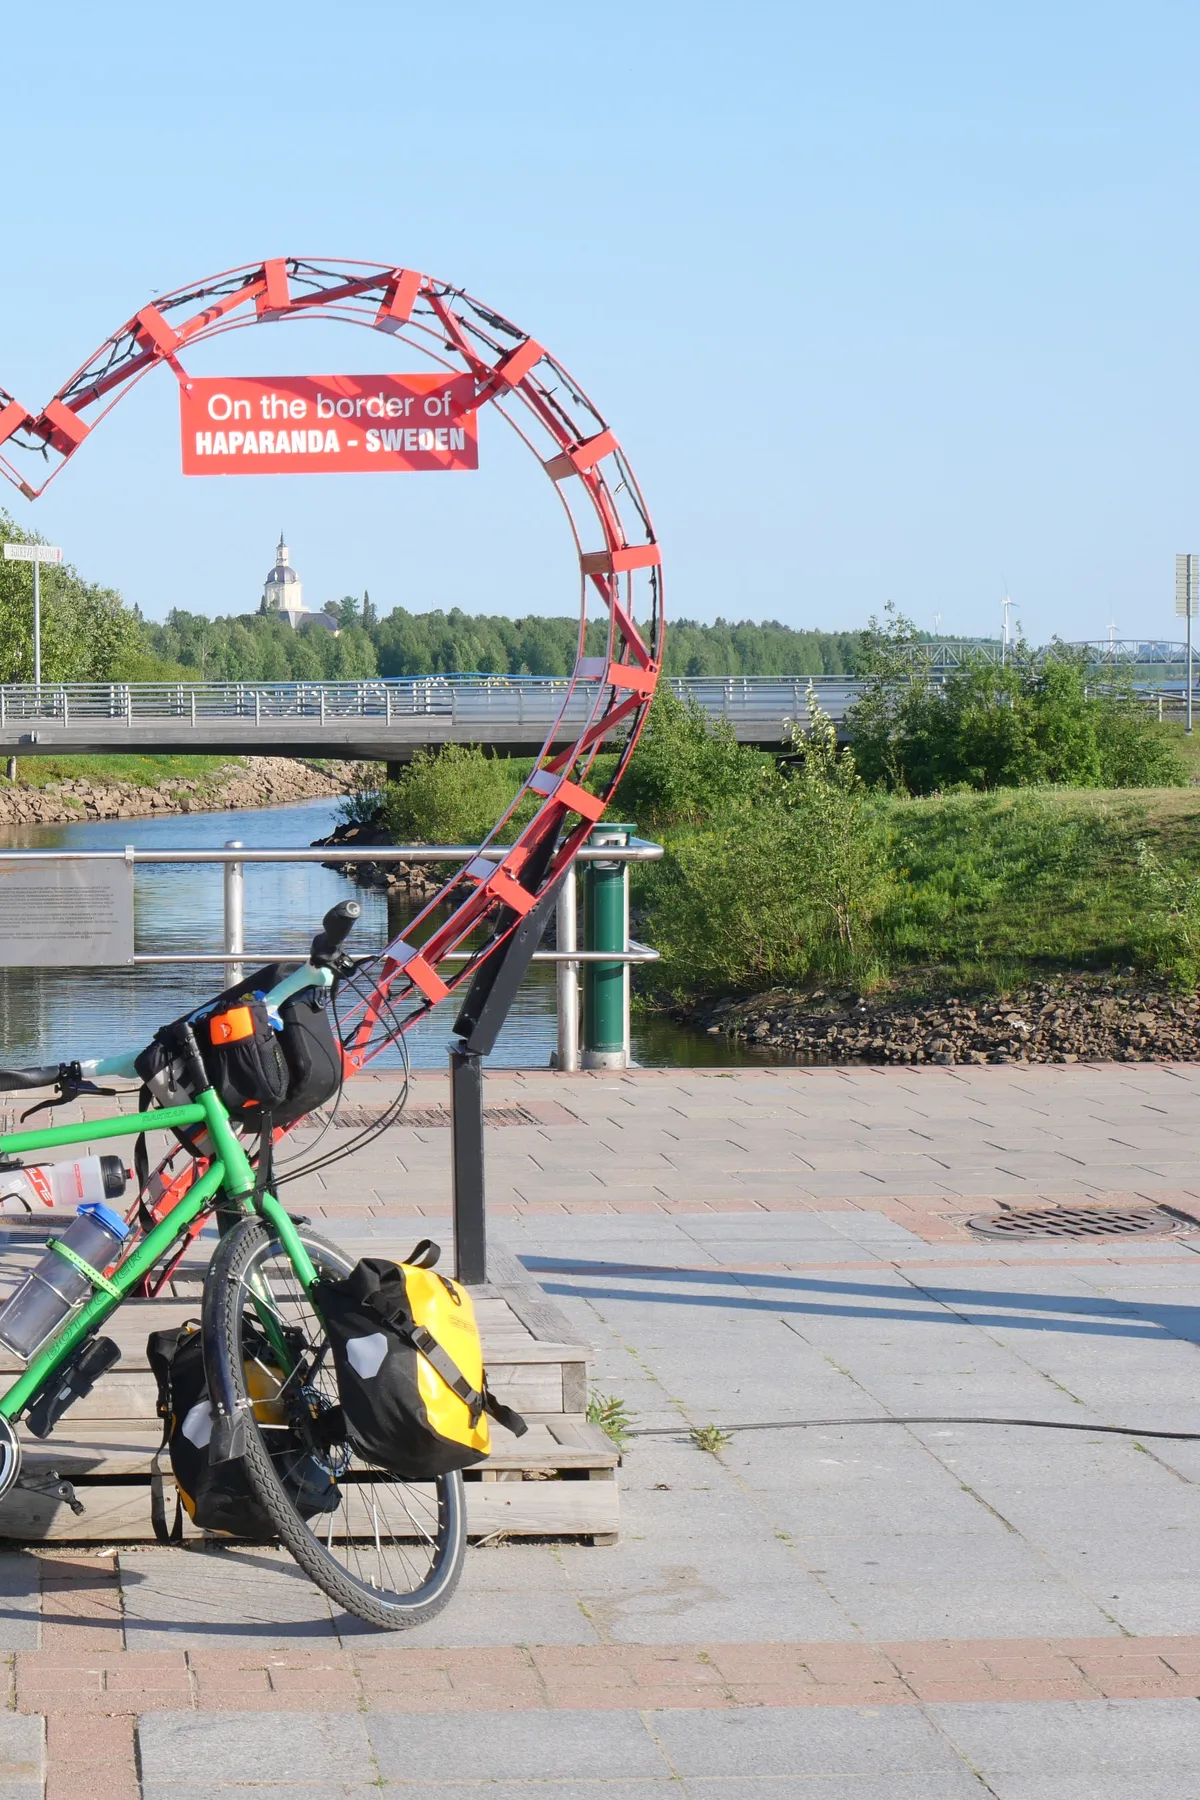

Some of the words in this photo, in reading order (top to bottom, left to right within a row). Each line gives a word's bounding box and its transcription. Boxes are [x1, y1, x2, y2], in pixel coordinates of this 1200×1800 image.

[207, 393, 252, 421] On
[260, 393, 307, 420] the
[317, 391, 415, 419] border
[423, 390, 452, 417] of
[195, 428, 340, 456] HAPARANDA
[346, 439, 358, 447] -
[365, 427, 465, 453] SWEDEN
